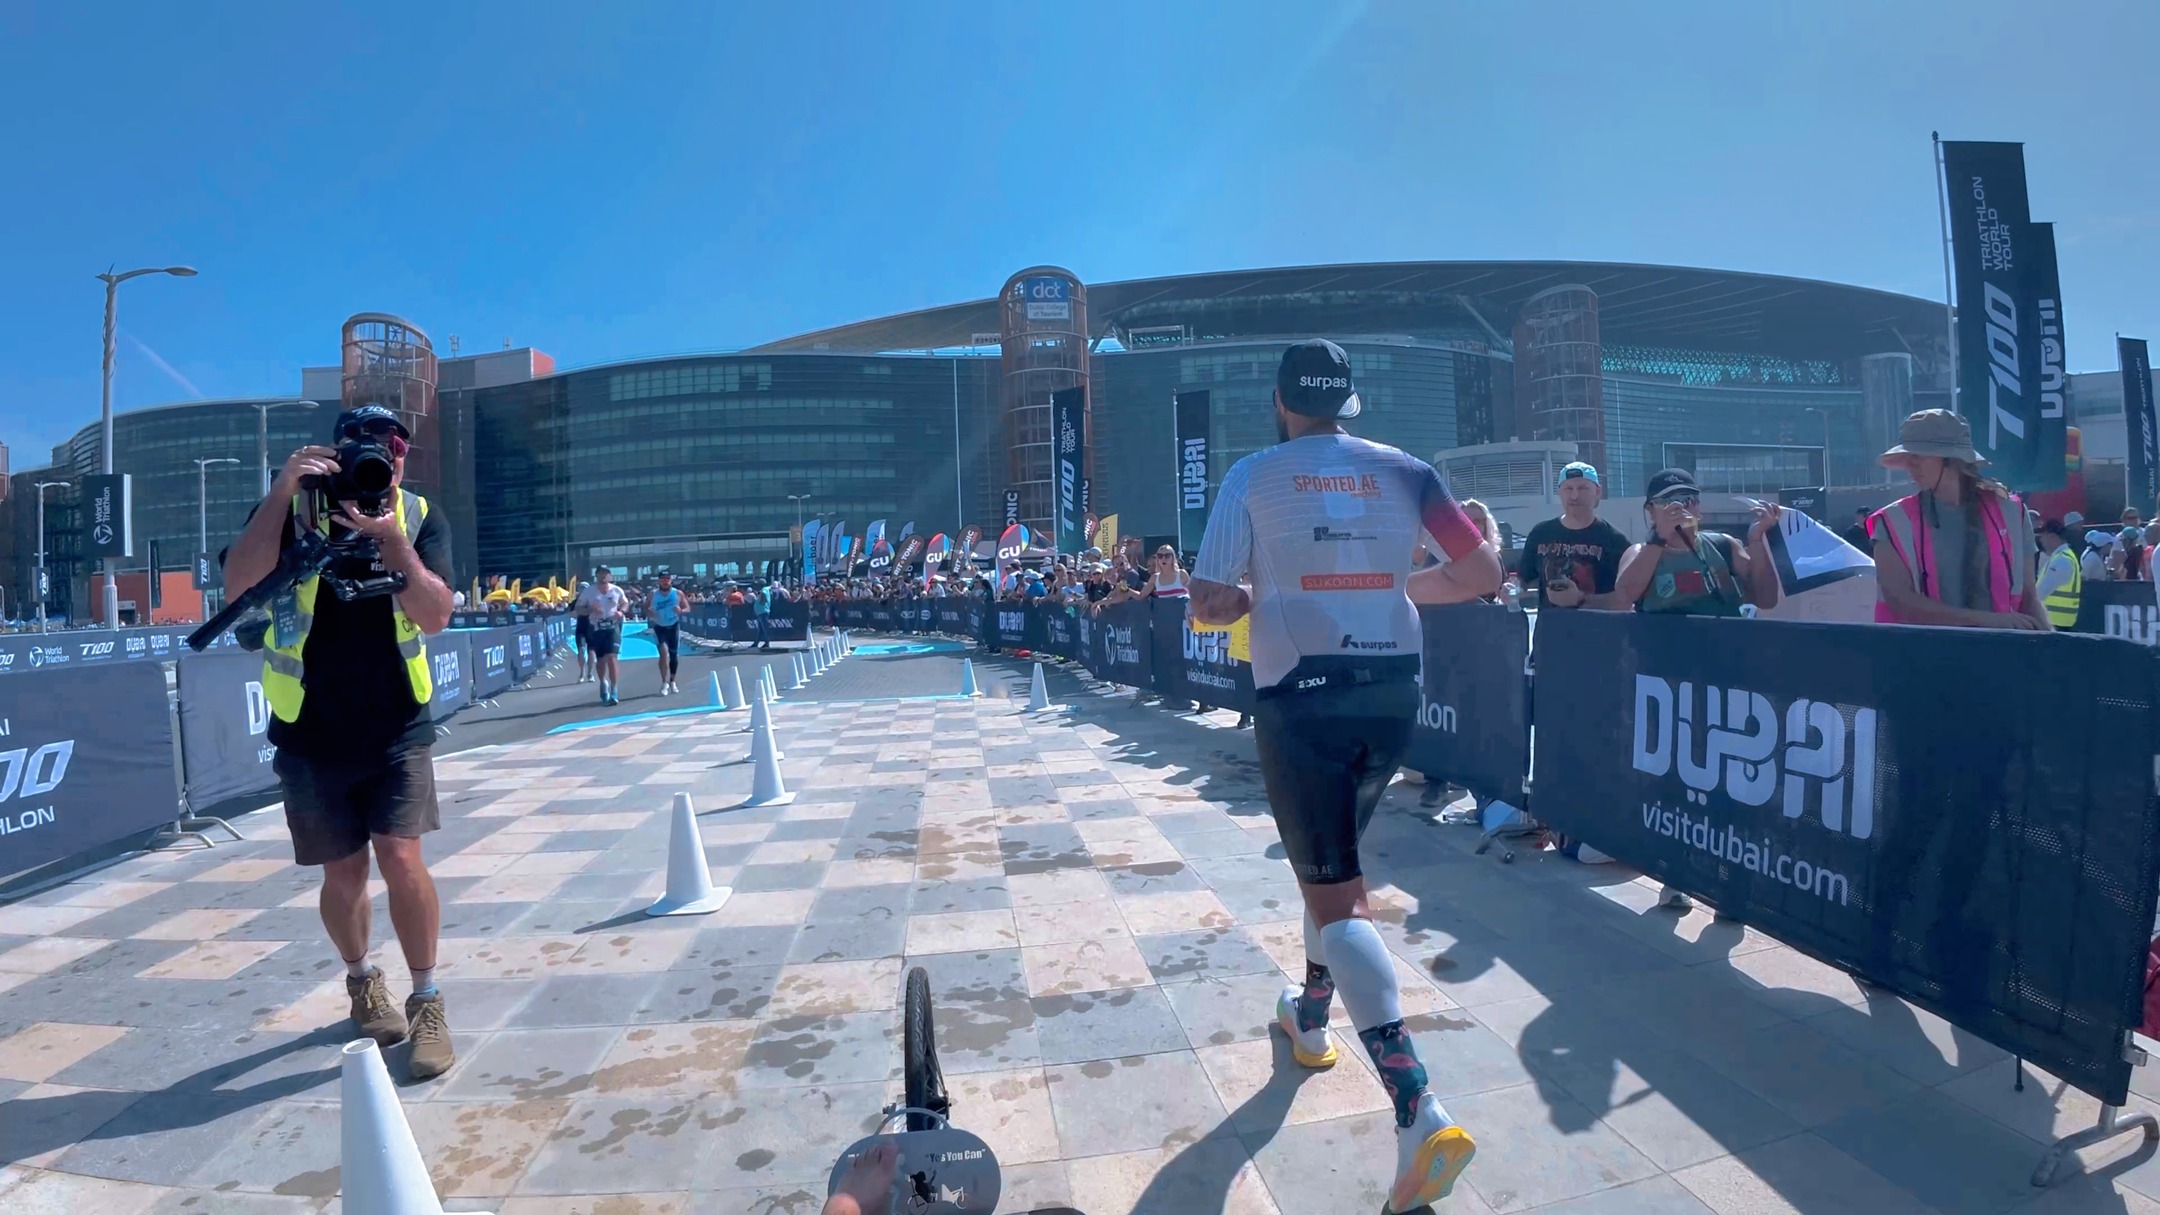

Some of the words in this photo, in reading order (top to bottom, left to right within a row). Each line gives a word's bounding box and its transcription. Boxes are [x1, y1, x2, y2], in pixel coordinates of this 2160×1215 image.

[1972, 176, 1991, 271] TRIATHLON
[1988, 208, 2003, 271] WORLD
[2000, 224, 2014, 272] TOUR
[1032, 281, 1062, 299] dct
[1984, 281, 2025, 450] T100
[1300, 376, 1347, 390] surpas
[1183, 437, 1207, 509] DUBAI
[1293, 474, 1380, 492] SPORTED.AE
[102, 486, 111, 523] Triathlon
[1006, 491, 1018, 526] ONIC
[1061, 459, 1075, 538] T100
[95, 498, 103, 523] World
[870, 556, 889, 568] GU
[893, 561, 904, 576] RIT
[901, 538, 918, 561] TONIC
[926, 552, 943, 563] GU
[999, 546, 1020, 559] GU
[953, 559, 961, 573] RIT
[1305, 576, 1392, 588] SUKOON.COM
[1115, 627, 1131, 644] World
[1360, 641, 1397, 650] surpas
[45, 646, 62, 655] World
[80, 641, 115, 656] T100
[483, 645, 505, 668] T100
[1116, 644, 1139, 663] Triathlon
[1186, 668, 1236, 690] visitdubai.com
[245, 680, 273, 736] D
[1632, 673, 1876, 840] DUBAI
[1643, 801, 1849, 907] visitdubai.com
[947, 1150, 963, 1161] You
